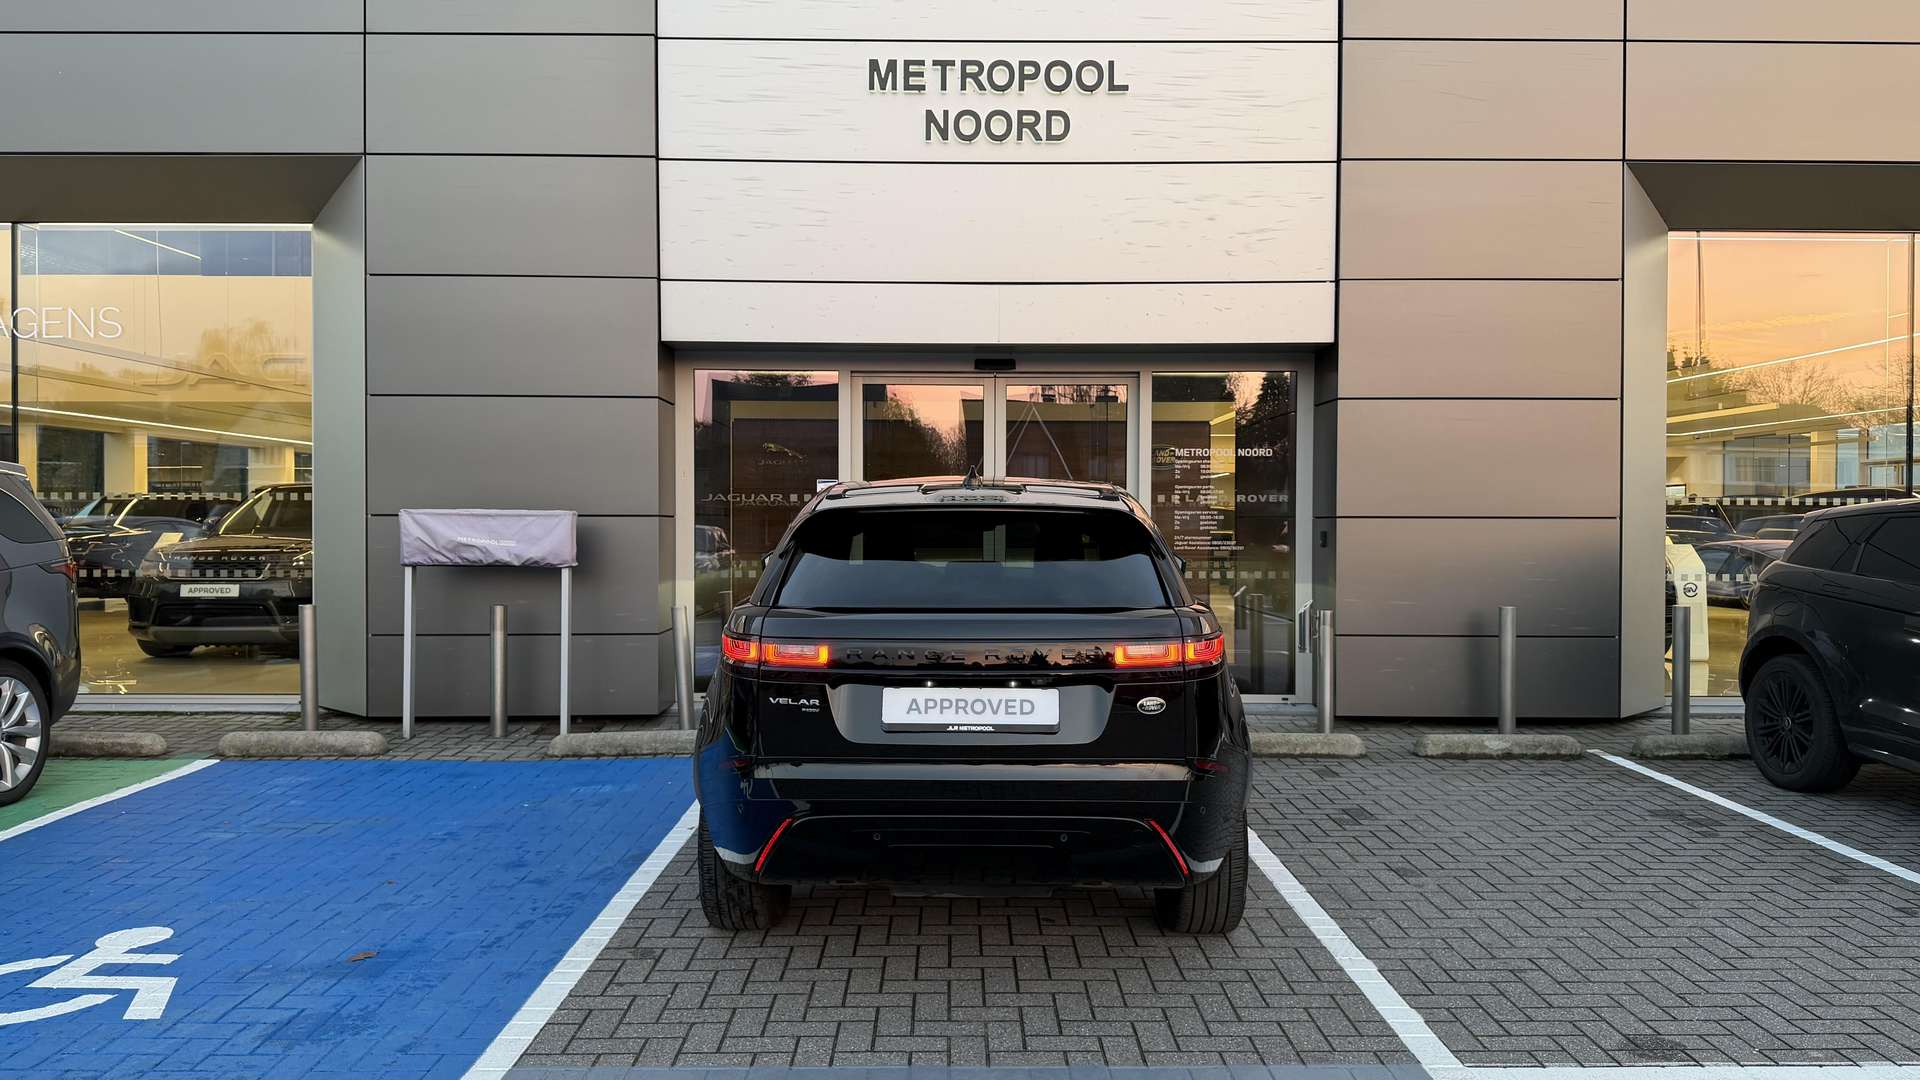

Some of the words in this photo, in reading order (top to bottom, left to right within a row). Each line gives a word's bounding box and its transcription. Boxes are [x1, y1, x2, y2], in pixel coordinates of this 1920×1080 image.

[868, 59, 1129, 92] METROPOOL
[925, 109, 1070, 142] NOORD
[1175, 448, 1236, 457] METROPOOL
[1238, 448, 1273, 457] NOORD
[702, 494, 783, 502] JAGUAR
[1237, 494, 1289, 502] ROVER
[846, 648, 966, 660] RANGE
[769, 697, 820, 705] VELAR
[906, 698, 1035, 715] APPROVED
